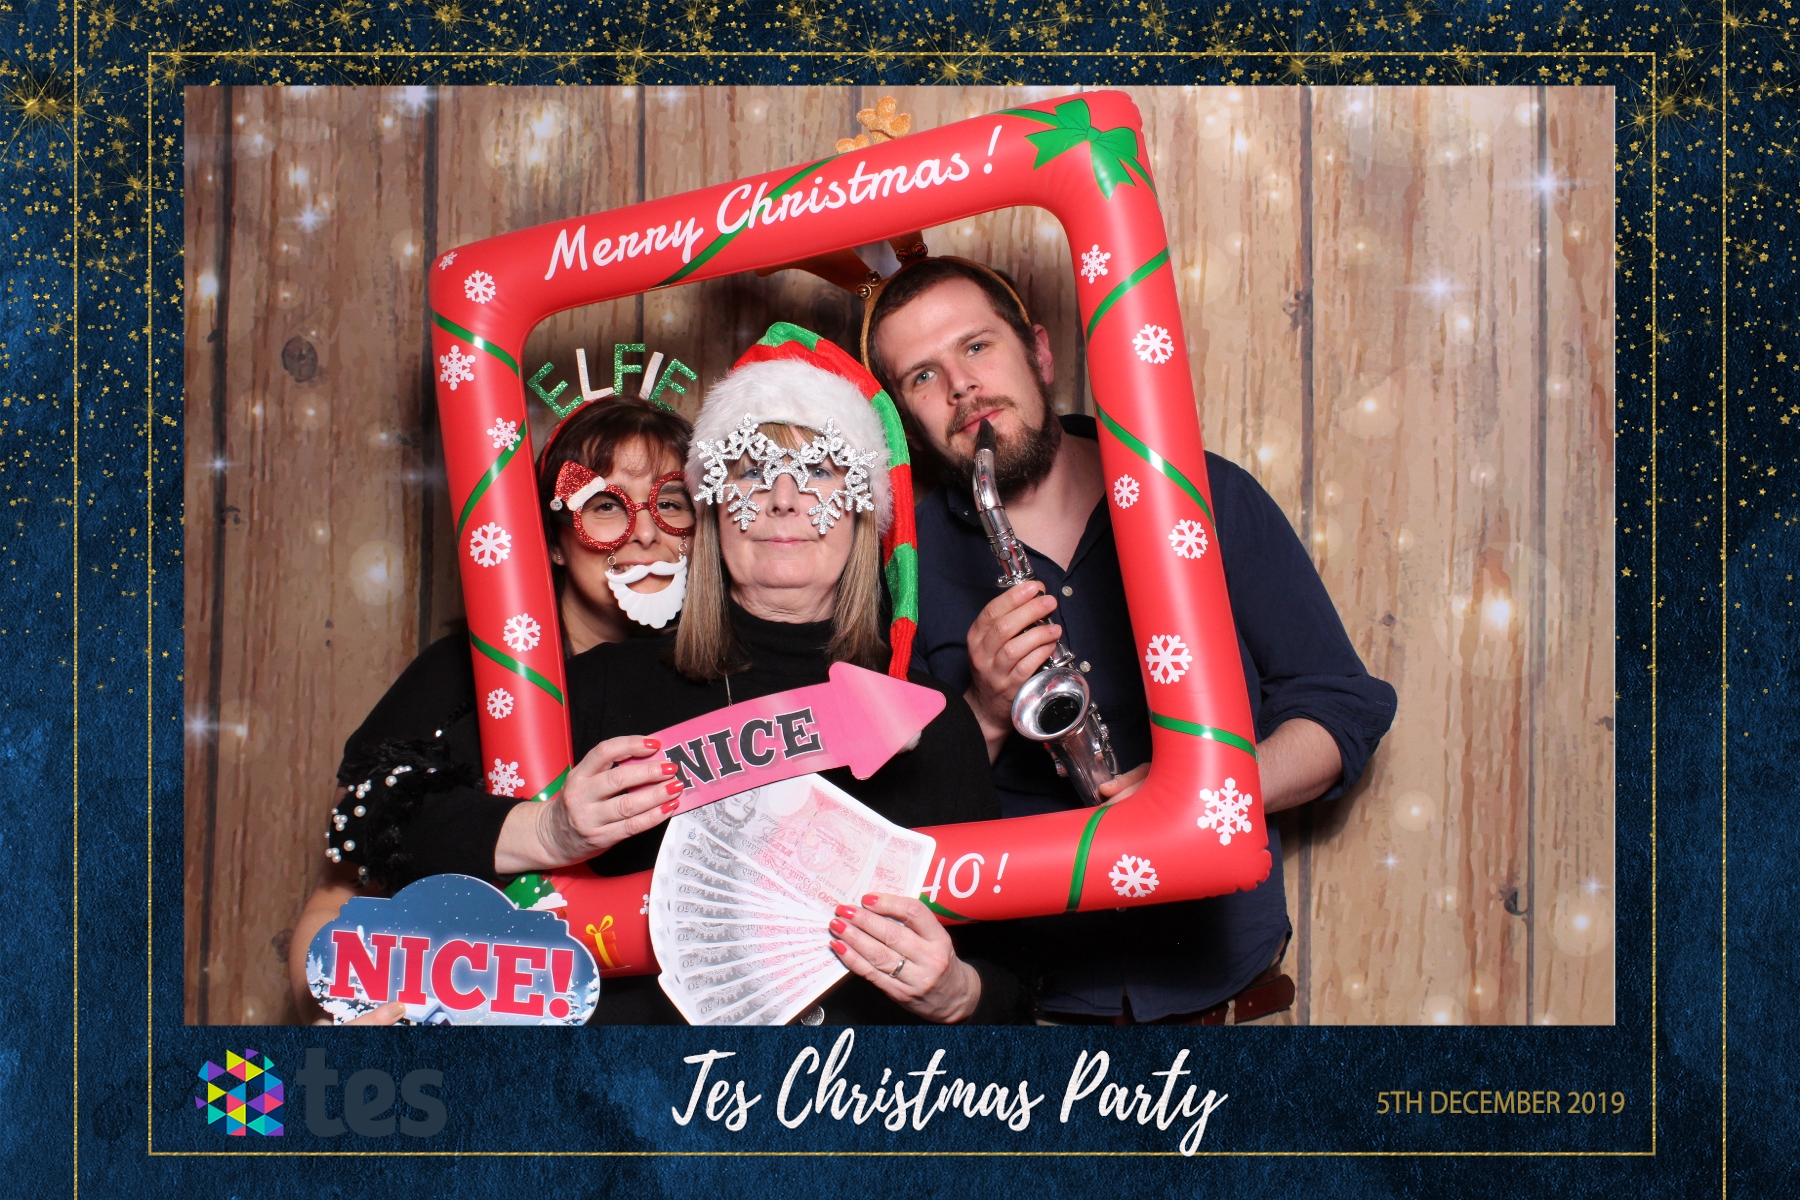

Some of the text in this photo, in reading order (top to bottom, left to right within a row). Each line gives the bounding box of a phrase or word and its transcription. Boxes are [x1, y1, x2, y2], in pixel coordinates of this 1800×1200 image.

[543, 217, 706, 282] Merry
[526, 343, 698, 420] ELFIE
[662, 706, 824, 791] NICE
[328, 929, 575, 1019] NICE!
